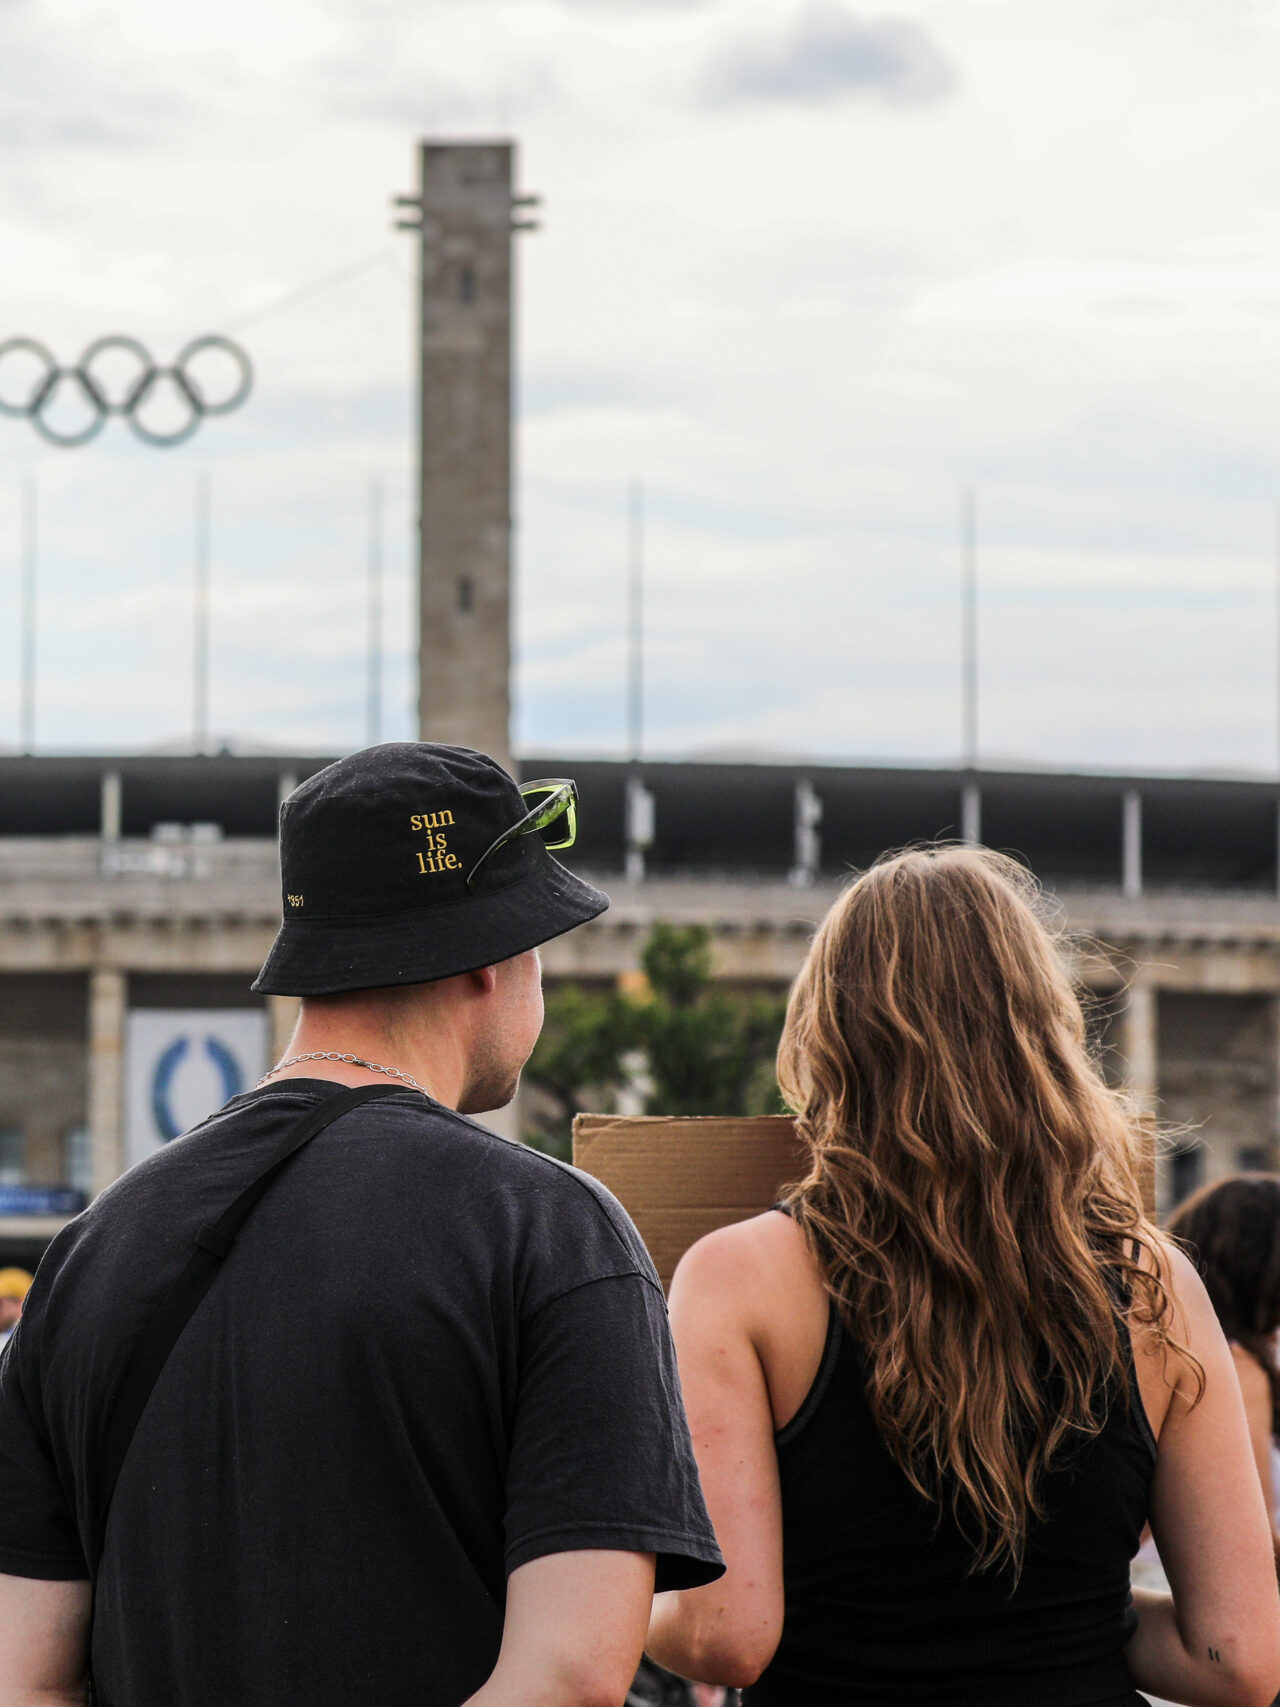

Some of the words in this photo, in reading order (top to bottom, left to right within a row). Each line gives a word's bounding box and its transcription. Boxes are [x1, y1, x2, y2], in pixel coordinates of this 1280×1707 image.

[410, 809, 456, 831] sun
[426, 829, 448, 851] is
[415, 849, 463, 874] life.
